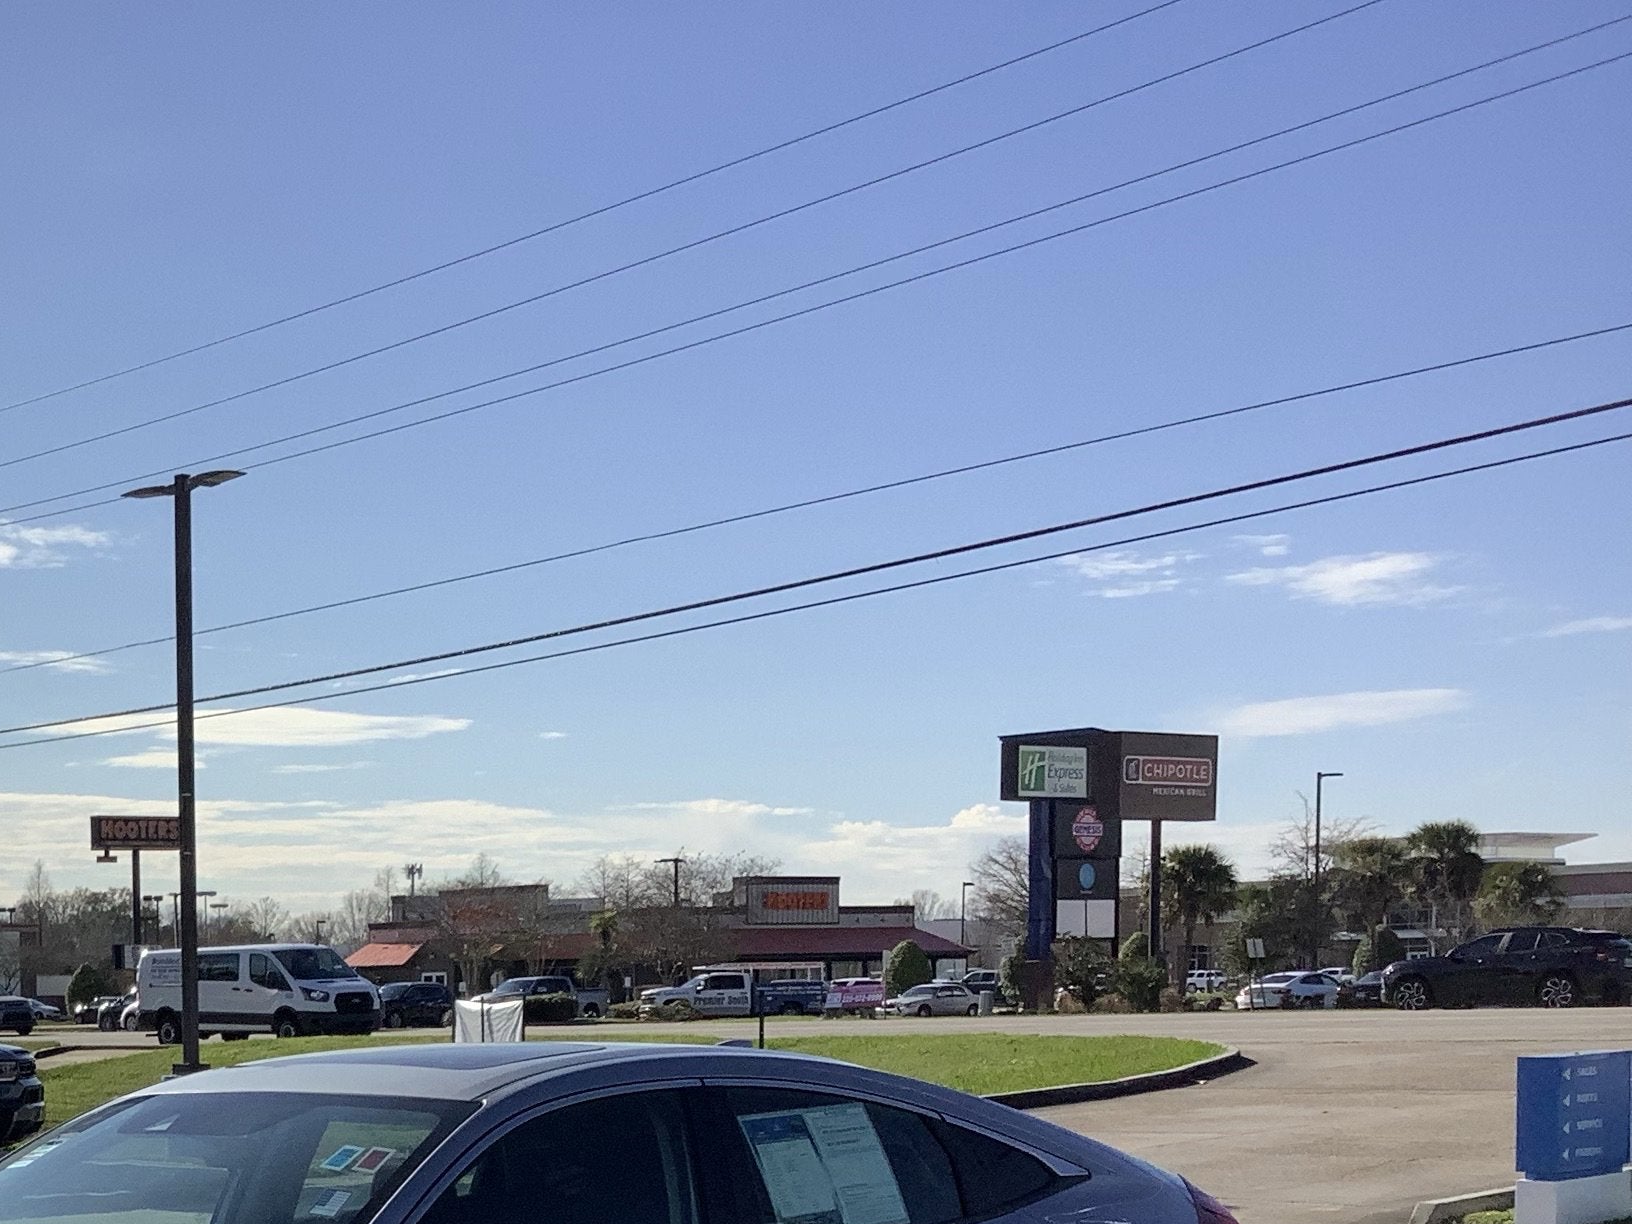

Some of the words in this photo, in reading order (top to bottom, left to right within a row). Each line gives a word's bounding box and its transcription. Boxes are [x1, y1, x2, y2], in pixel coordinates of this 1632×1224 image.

[1048, 763, 1084, 782] Express
[1144, 763, 1208, 779] CHIPOTLE
[100, 820, 179, 840] HOOTERS
